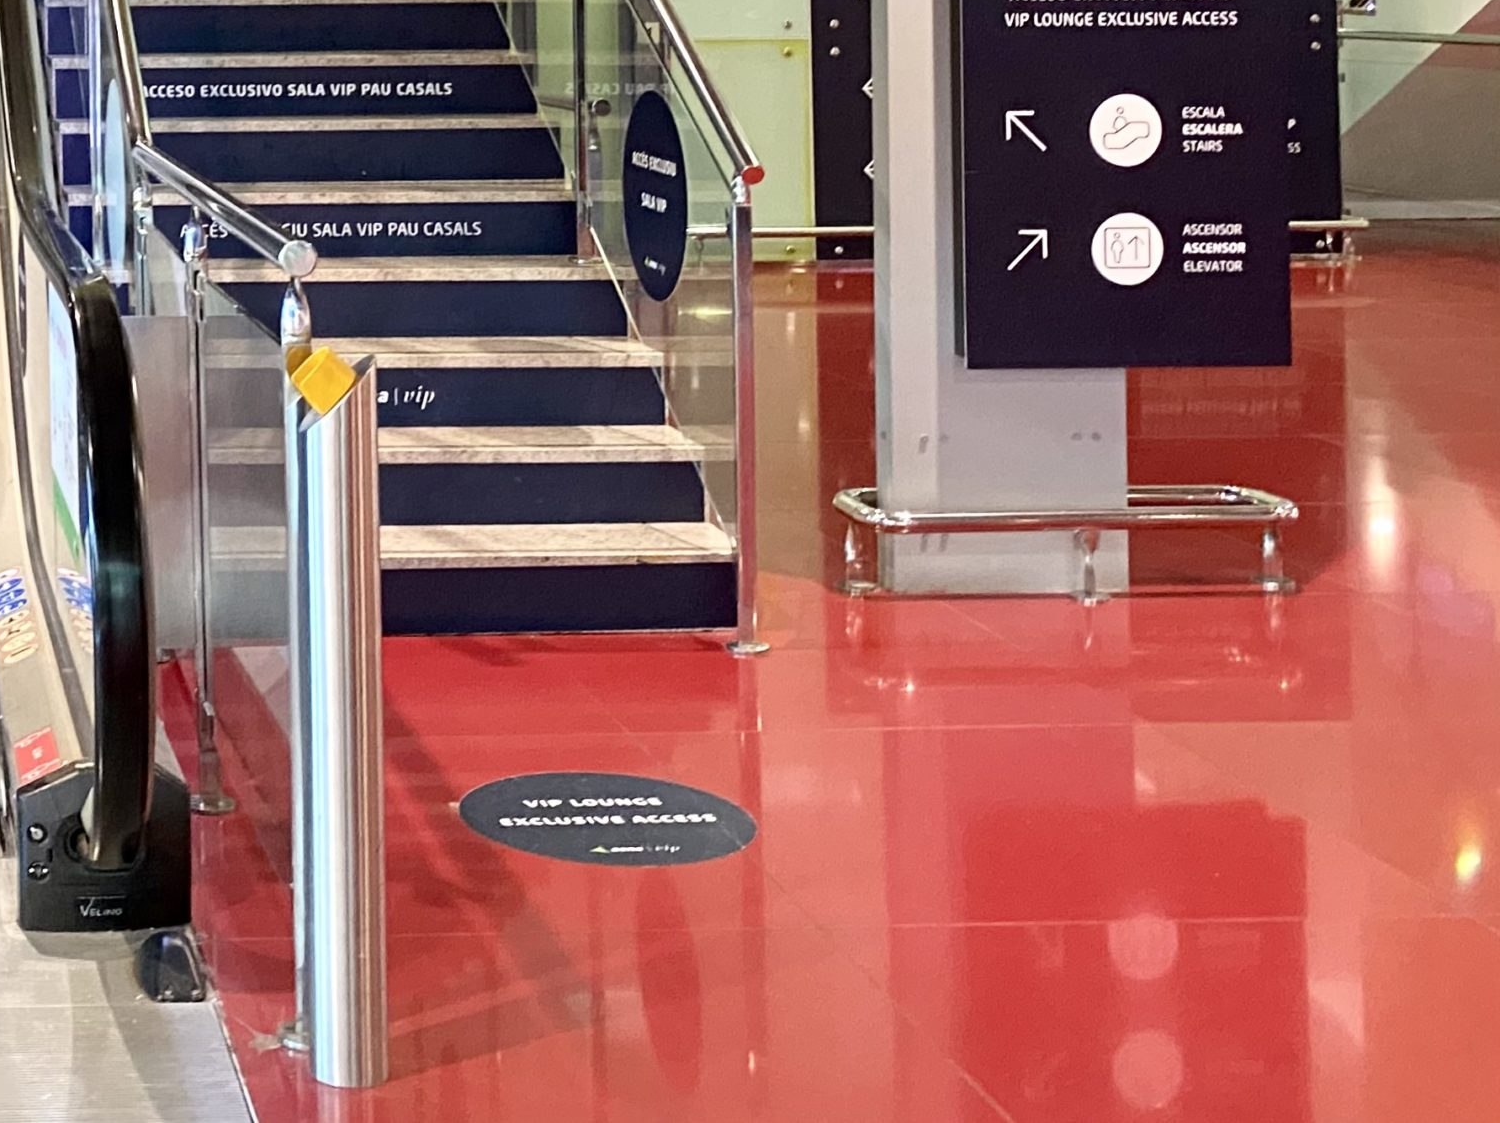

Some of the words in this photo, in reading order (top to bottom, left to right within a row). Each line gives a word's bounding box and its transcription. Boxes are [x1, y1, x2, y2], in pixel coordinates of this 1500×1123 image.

[1004, 13, 1029, 27] VIP
[1034, 12, 1093, 27] LOUNGE
[1098, 12, 1178, 26] EXCLUSIVE
[1182, 11, 1238, 26] ACCESS
[200, 84, 282, 97] EXCLUSIVO
[287, 84, 325, 96] SALA
[330, 84, 356, 96] VIP
[361, 83, 391, 96] PAU
[396, 83, 452, 96] CASALS
[1182, 107, 1225, 118] ESCALA
[1182, 124, 1243, 135] ESCALERA
[1182, 141, 1223, 152] STAIRS
[312, 224, 350, 237] SALA
[357, 223, 382, 236] VIP
[388, 223, 418, 236] PAU
[423, 222, 482, 236] CASALS
[1182, 224, 1242, 235] ASCENSOR
[1182, 243, 1246, 254] ASCENSOR
[1183, 261, 1243, 272] ELEVATOR
[403, 385, 435, 409] vip
[523, 799, 563, 808] VIP
[569, 797, 663, 807] LOUNGE
[499, 815, 625, 827] EXCLUSIVE
[632, 814, 717, 824] ACCESS
